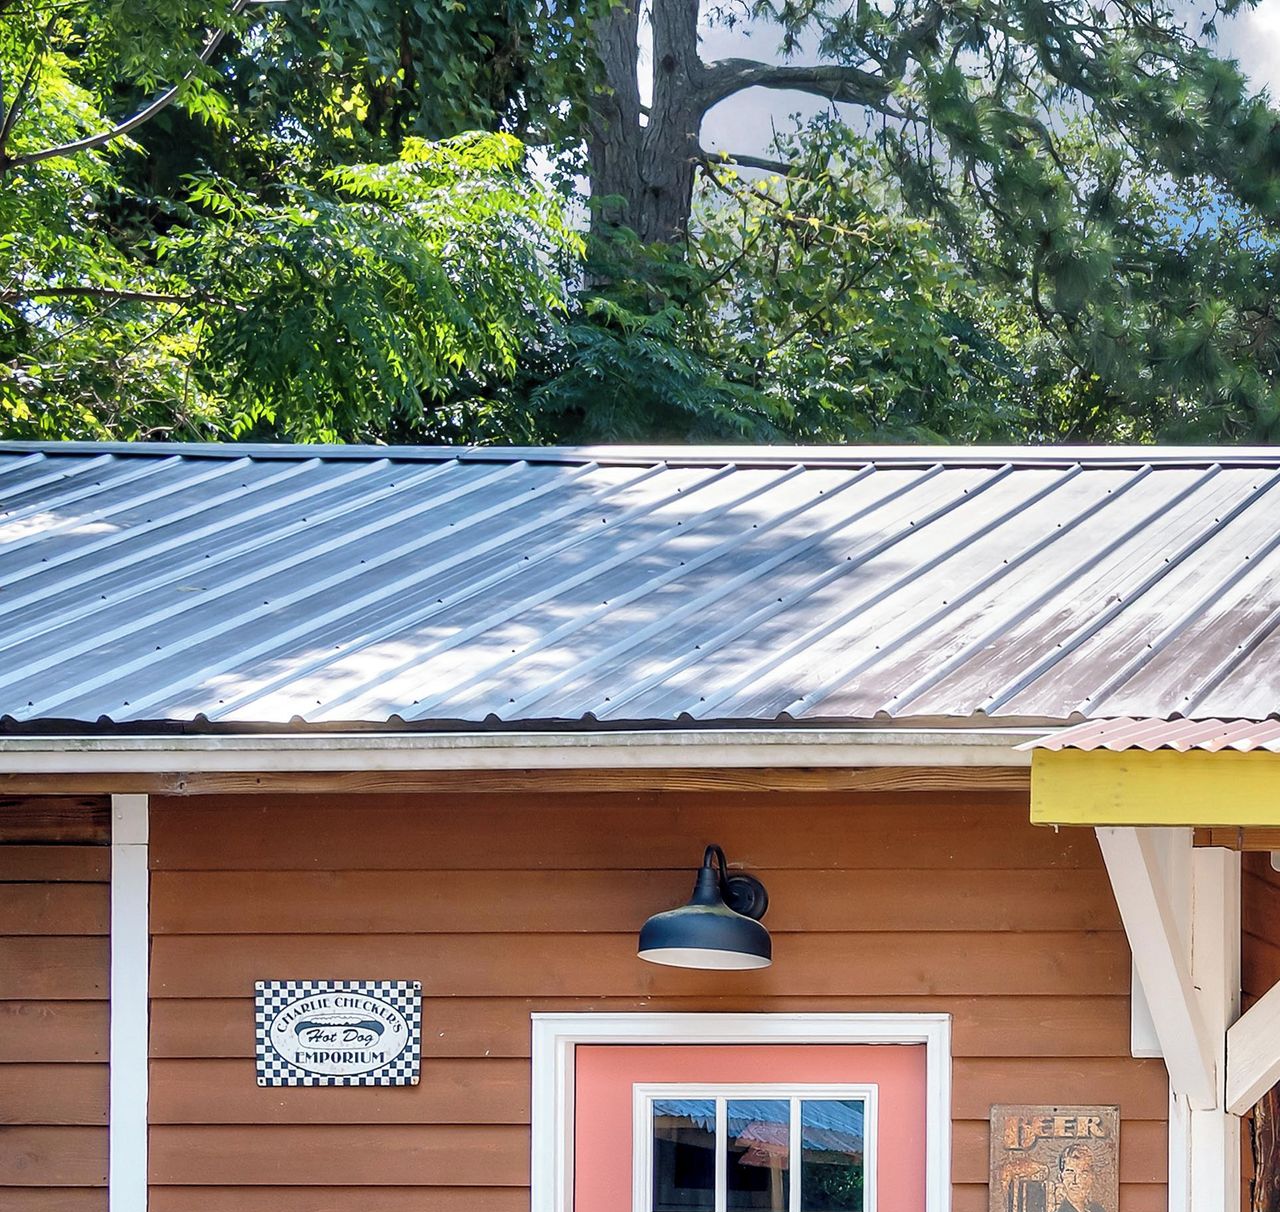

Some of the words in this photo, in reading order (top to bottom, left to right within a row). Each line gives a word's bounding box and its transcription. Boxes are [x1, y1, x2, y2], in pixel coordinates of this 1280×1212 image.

[277, 997, 331, 1033] CHARLIE
[335, 997, 403, 1034] CHECKER'S
[306, 1028, 337, 1043] Hot
[343, 1028, 374, 1047] Dog
[295, 1051, 385, 1064] EMPORIUM
[1004, 1114, 1106, 1150] BEER
